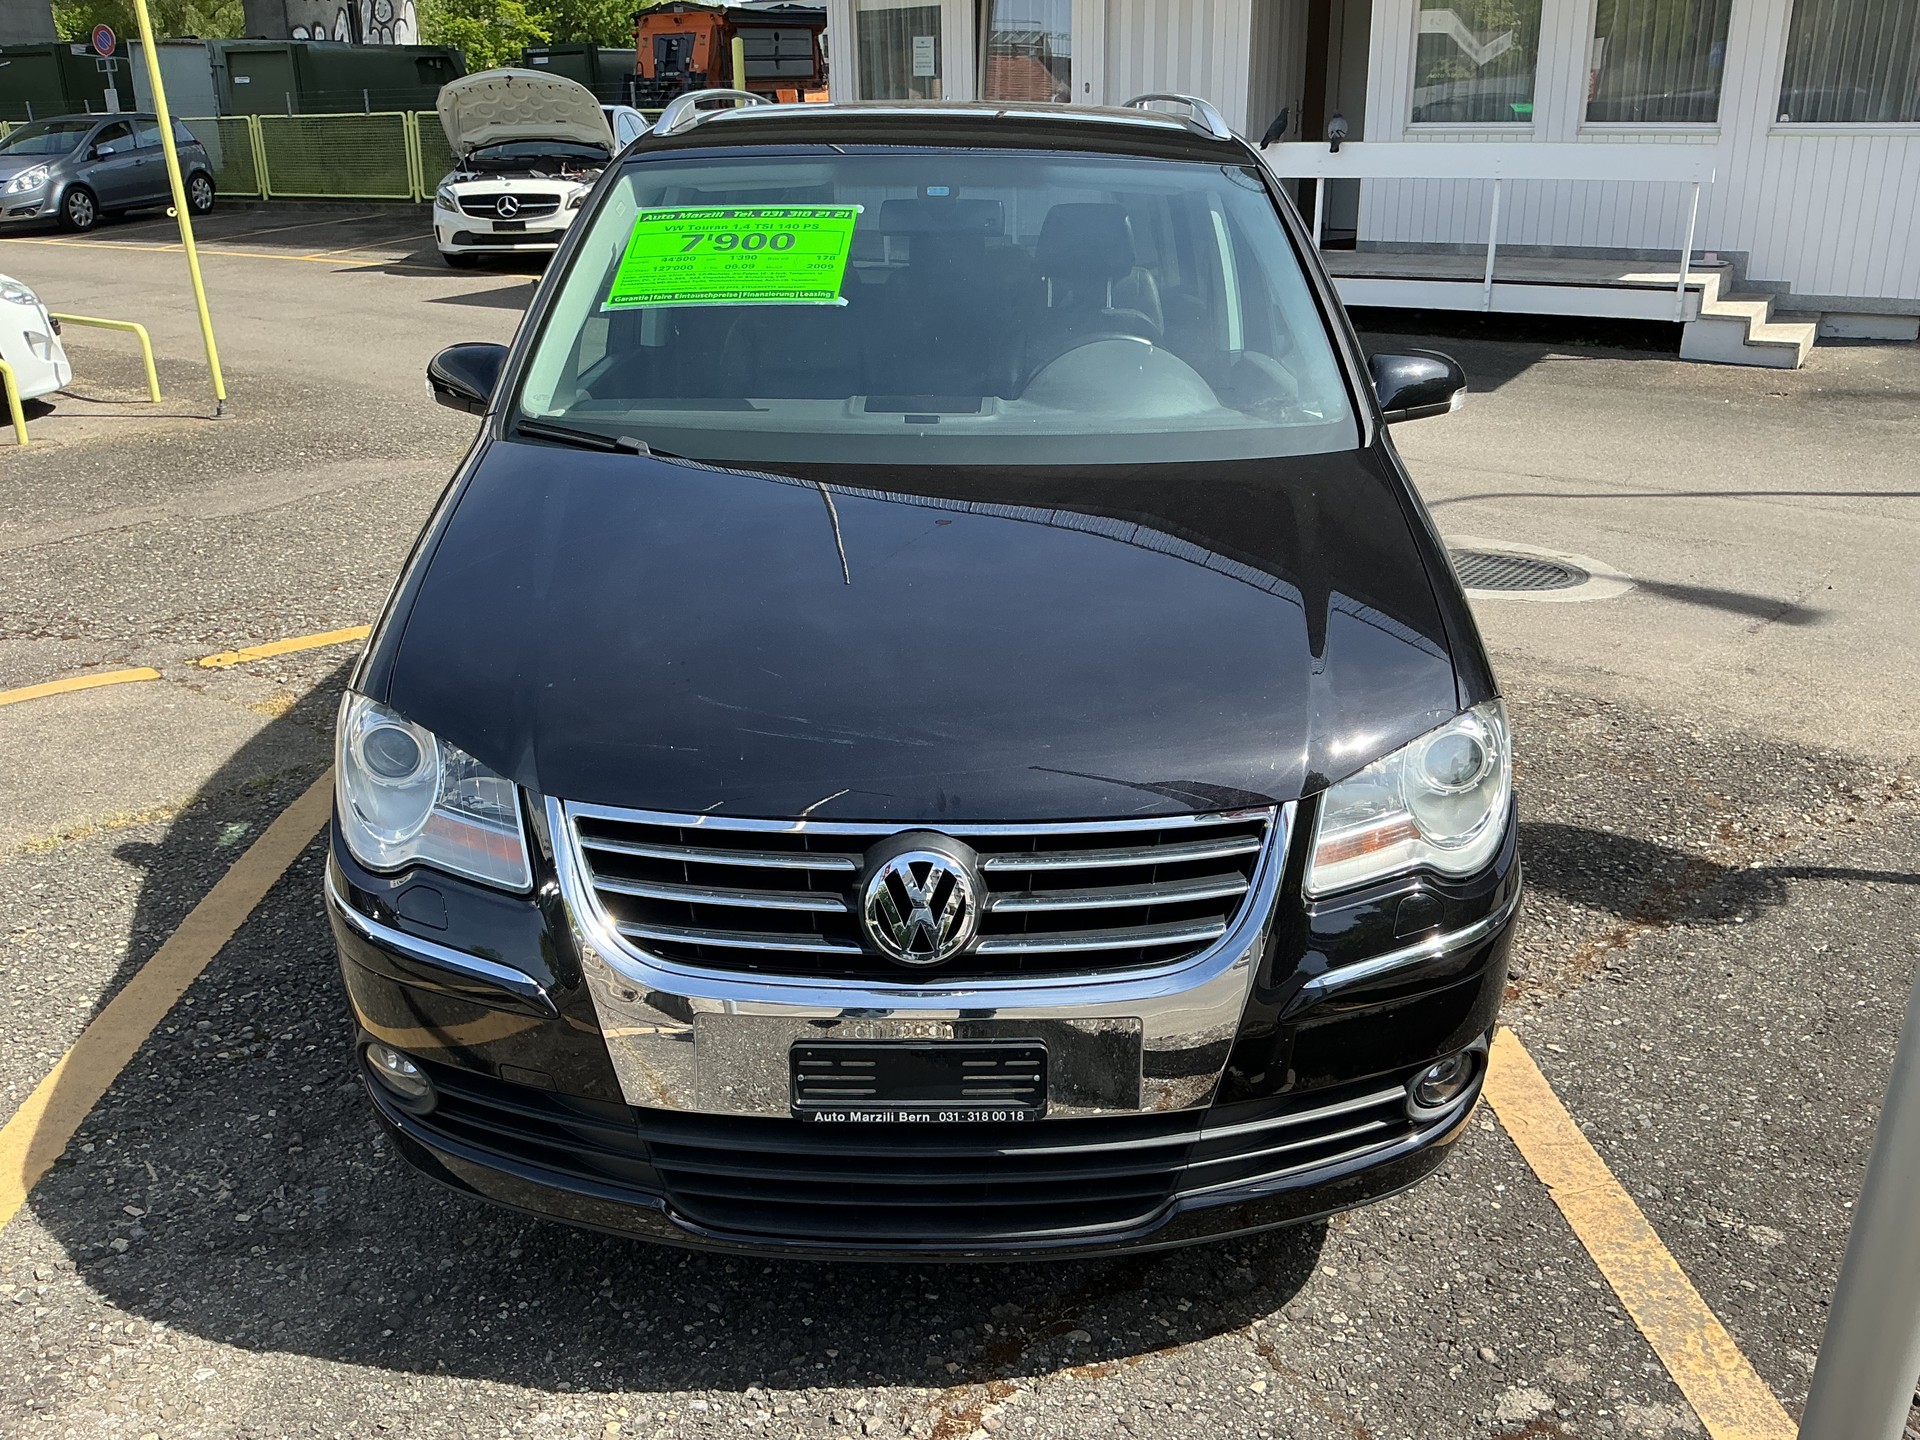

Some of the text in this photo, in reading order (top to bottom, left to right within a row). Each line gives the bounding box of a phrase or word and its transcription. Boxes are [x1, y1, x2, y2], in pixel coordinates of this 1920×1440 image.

[643, 213, 675, 222] Auto
[734, 210, 755, 218] Tel.
[815, 210, 830, 218] 21
[679, 232, 796, 252] 7'900
[814, 1112, 846, 1122] Auto
[850, 1111, 894, 1122] Marzili
[900, 1111, 930, 1122] Bern
[992, 1111, 1007, 1122] 00
[1010, 1111, 1024, 1121] 18
